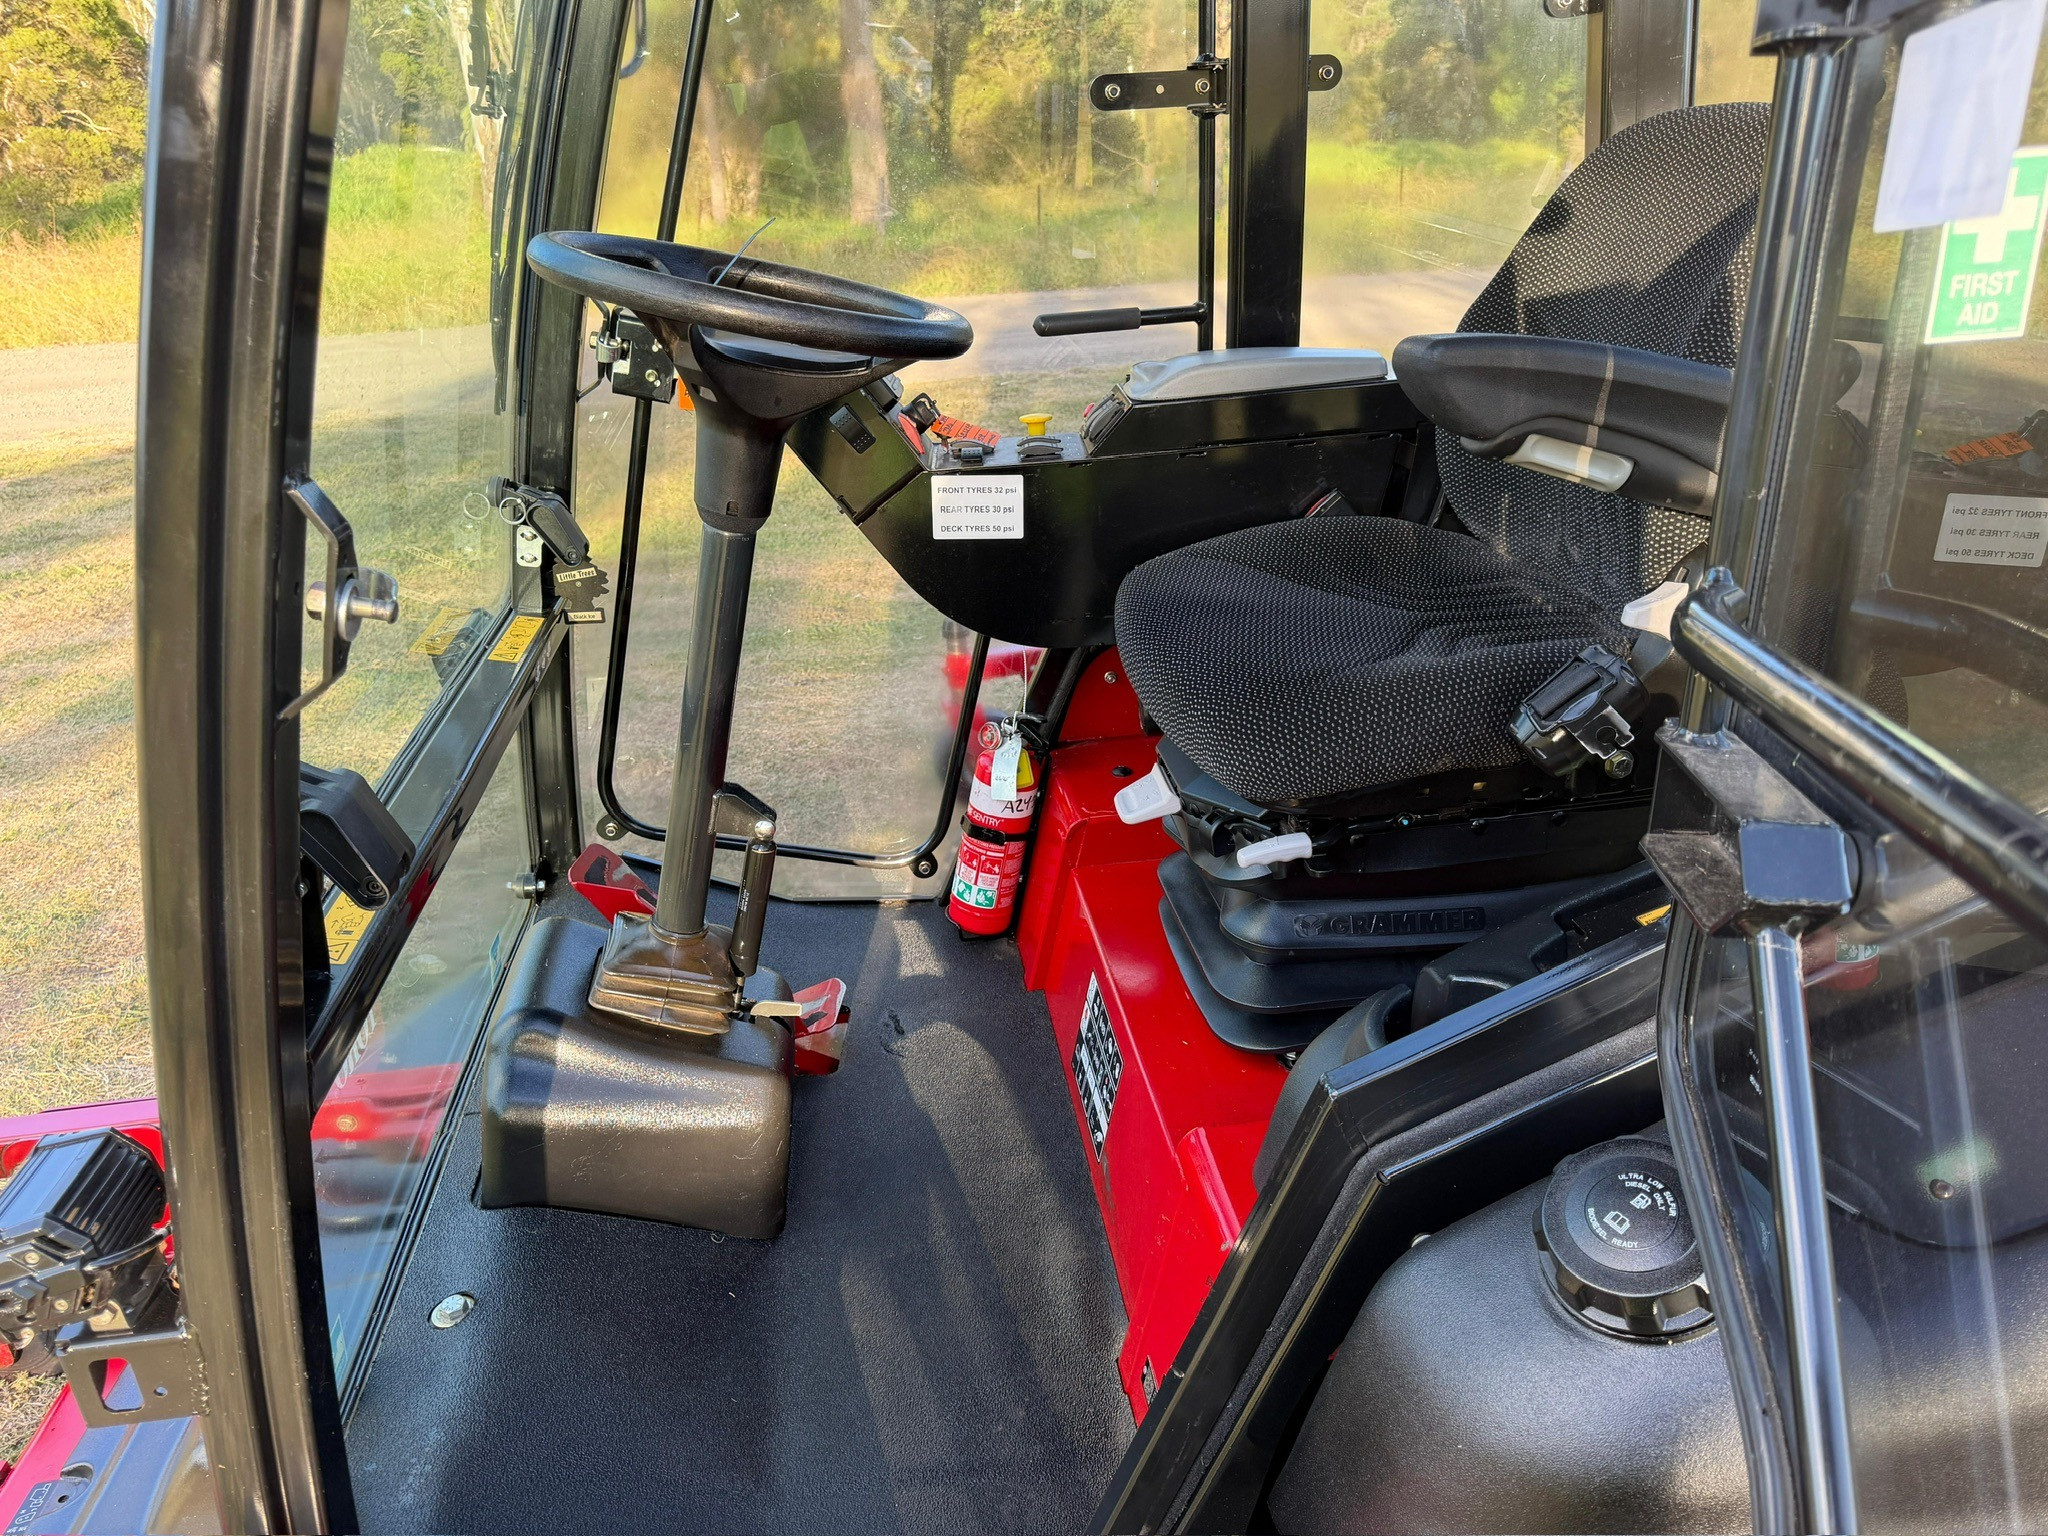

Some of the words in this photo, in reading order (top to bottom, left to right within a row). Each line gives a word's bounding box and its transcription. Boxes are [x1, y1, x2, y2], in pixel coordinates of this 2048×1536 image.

[1950, 270, 2020, 299] FIRST
[1955, 301, 2000, 327] AID
[1005, 486, 1017, 495] psi
[940, 505, 963, 513] REAR
[964, 505, 991, 513] TYRES
[992, 505, 1001, 513] 30
[1002, 505, 1015, 514] psi
[1002, 525, 1015, 533] psi
[559, 572, 576, 581] Little
[577, 569, 595, 578] Trees
[972, 810, 1001, 827] SENTRY
[1329, 908, 1481, 935] GRAMMER
[1617, 1172, 1644, 1180] ULTRA
[1647, 1177, 1665, 1190] LOW
[1663, 1191, 1677, 1217] SULFUR
[1625, 1181, 1650, 1192] DIESEL
[1653, 1192, 1666, 1211] ONLY
[1588, 1207, 1607, 1240] BIODIESEL
[1611, 1237, 1638, 1248] READY
